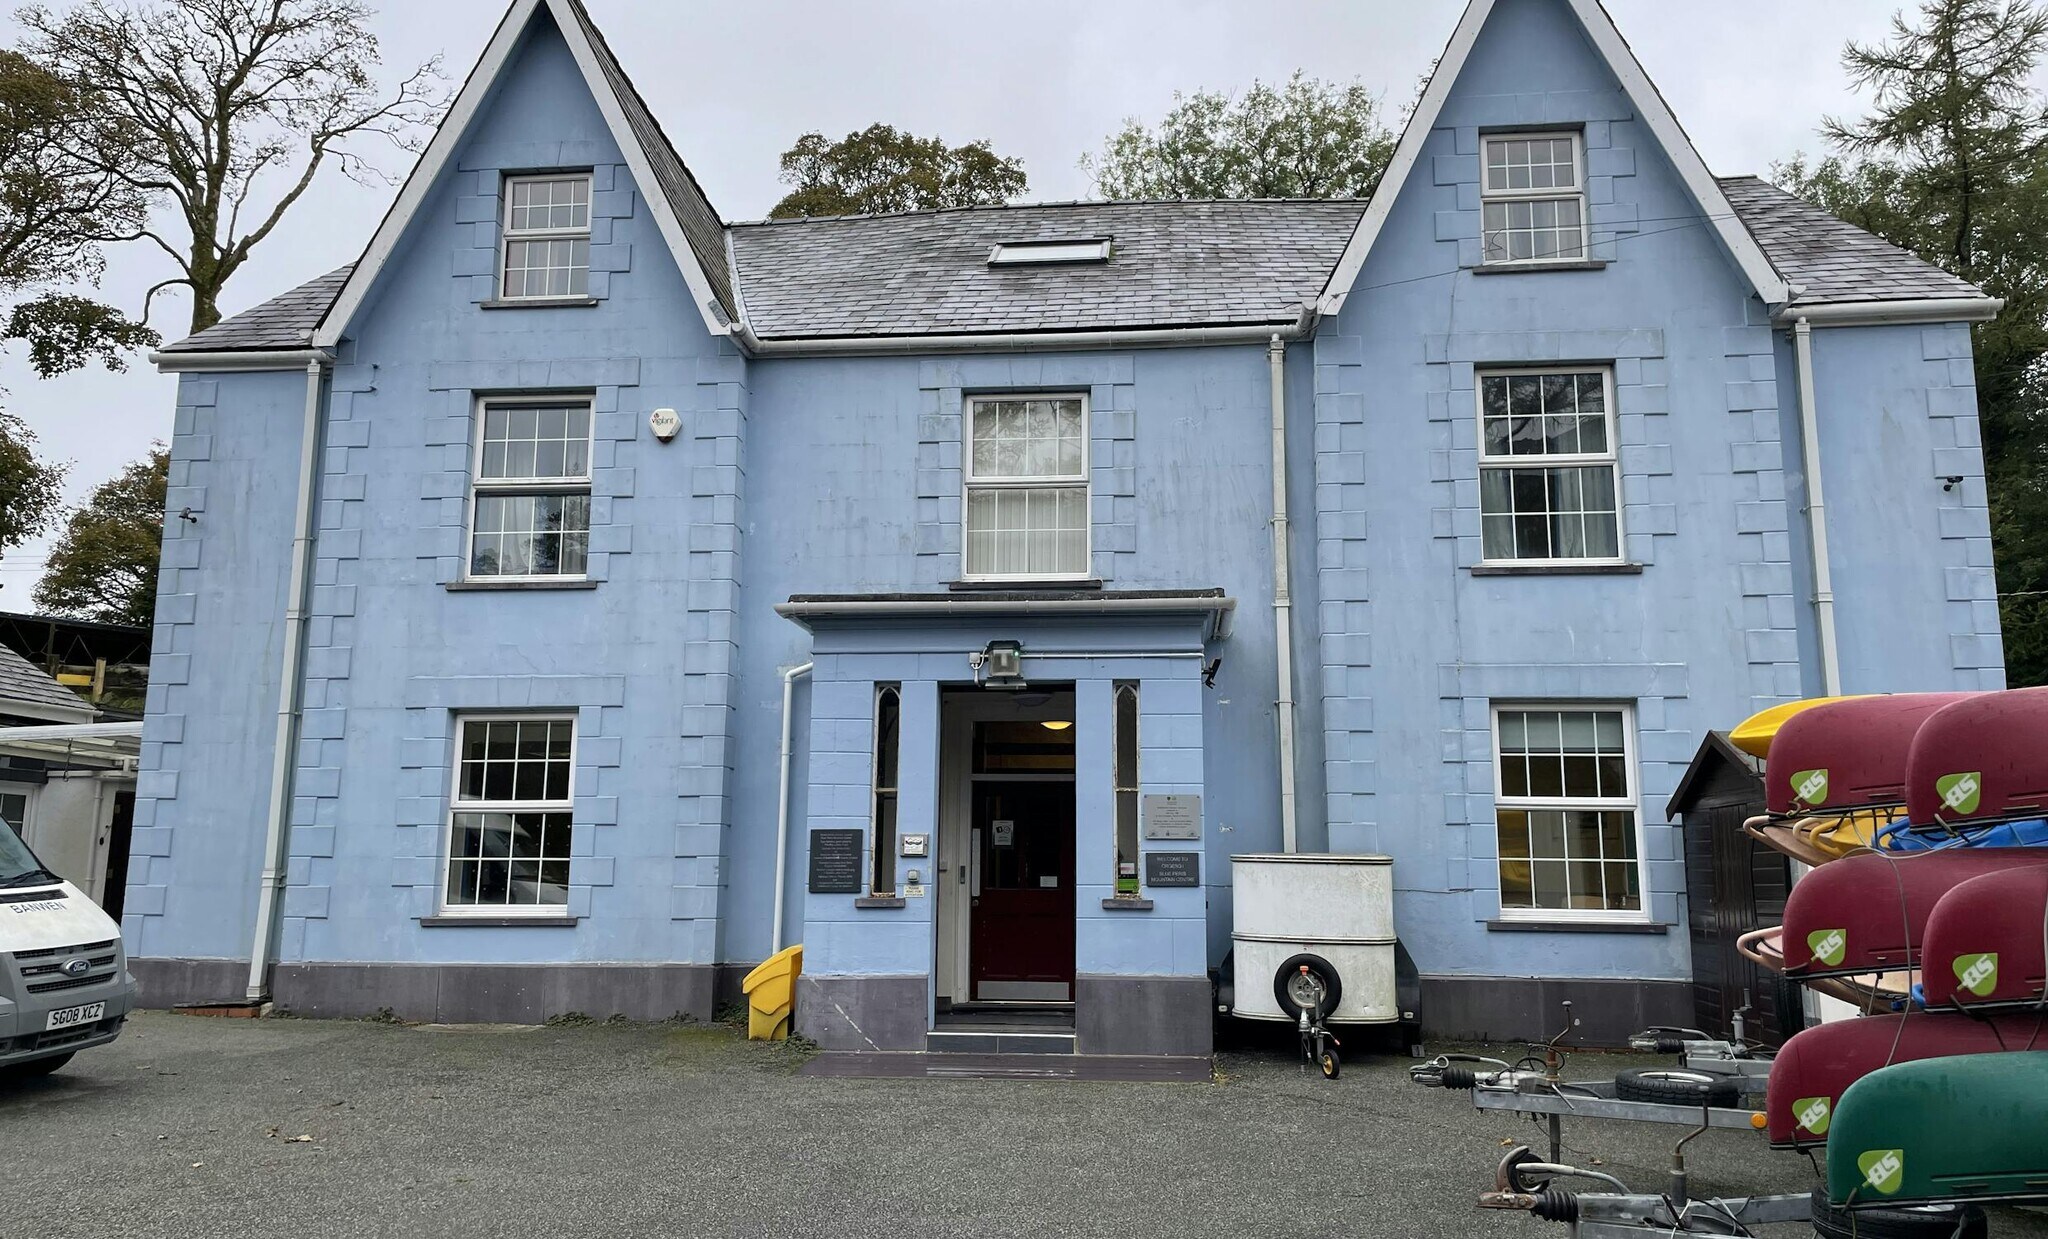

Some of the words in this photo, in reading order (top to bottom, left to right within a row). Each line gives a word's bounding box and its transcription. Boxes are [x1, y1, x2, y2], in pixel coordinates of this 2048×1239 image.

[10, 901, 67, 914] BANWEN
[73, 962, 87, 972] Ford
[52, 1010, 79, 1026] SG08
[82, 1003, 102, 1019] XCZ
